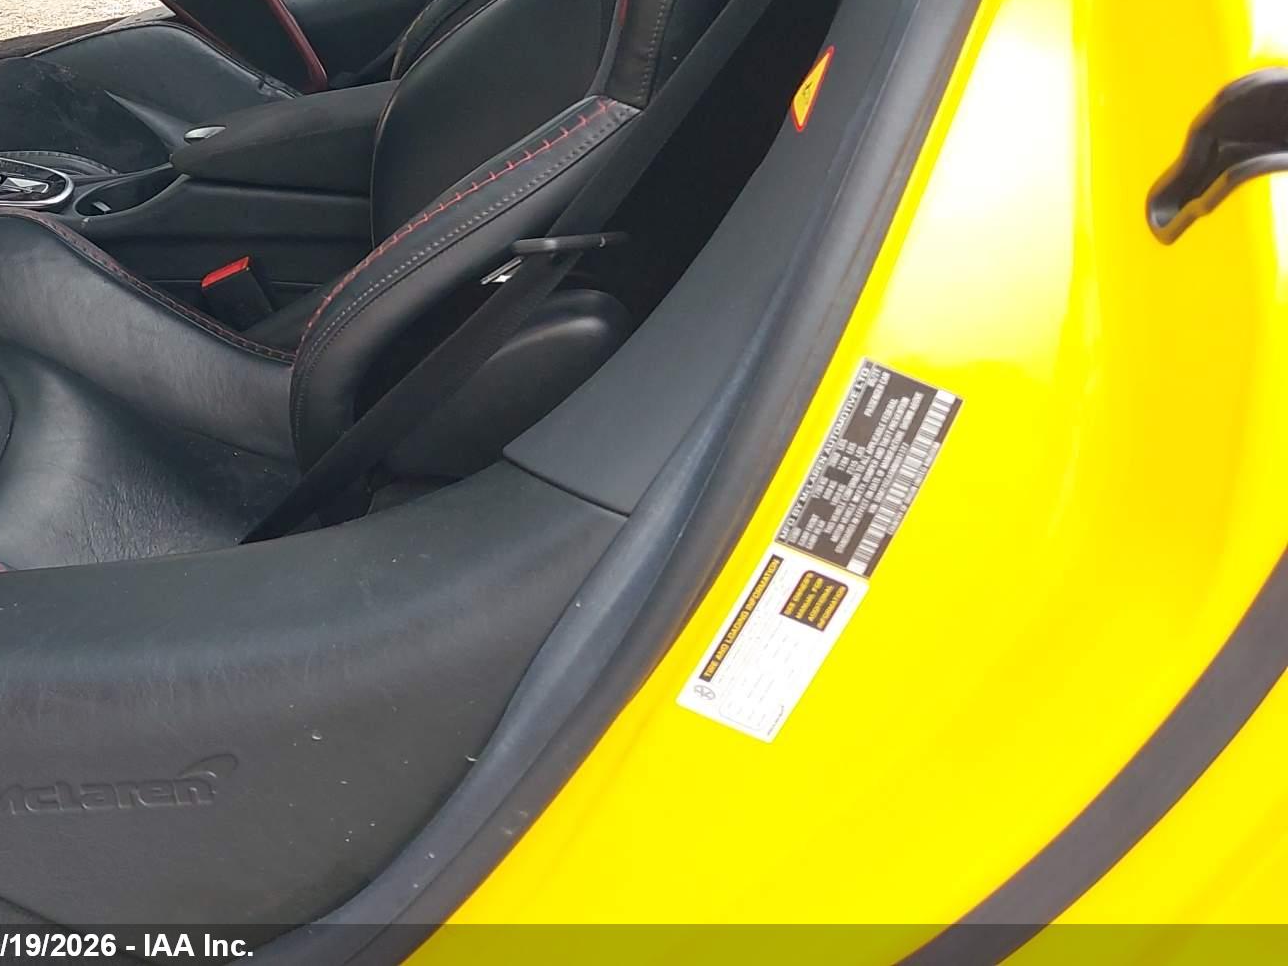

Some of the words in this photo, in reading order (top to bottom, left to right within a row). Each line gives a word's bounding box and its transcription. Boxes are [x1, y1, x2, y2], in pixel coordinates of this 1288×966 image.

[779, 517, 795, 539] MFD
[790, 502, 803, 516] BY
[798, 455, 827, 502] McLAREN
[821, 389, 860, 455] AUTOMOTIVE
[854, 366, 871, 389] LTD
[703, 660, 719, 677] TIRE
[713, 642, 729, 660] AND
[723, 609, 749, 644] LOADING
[743, 558, 781, 611] INFORMATION
